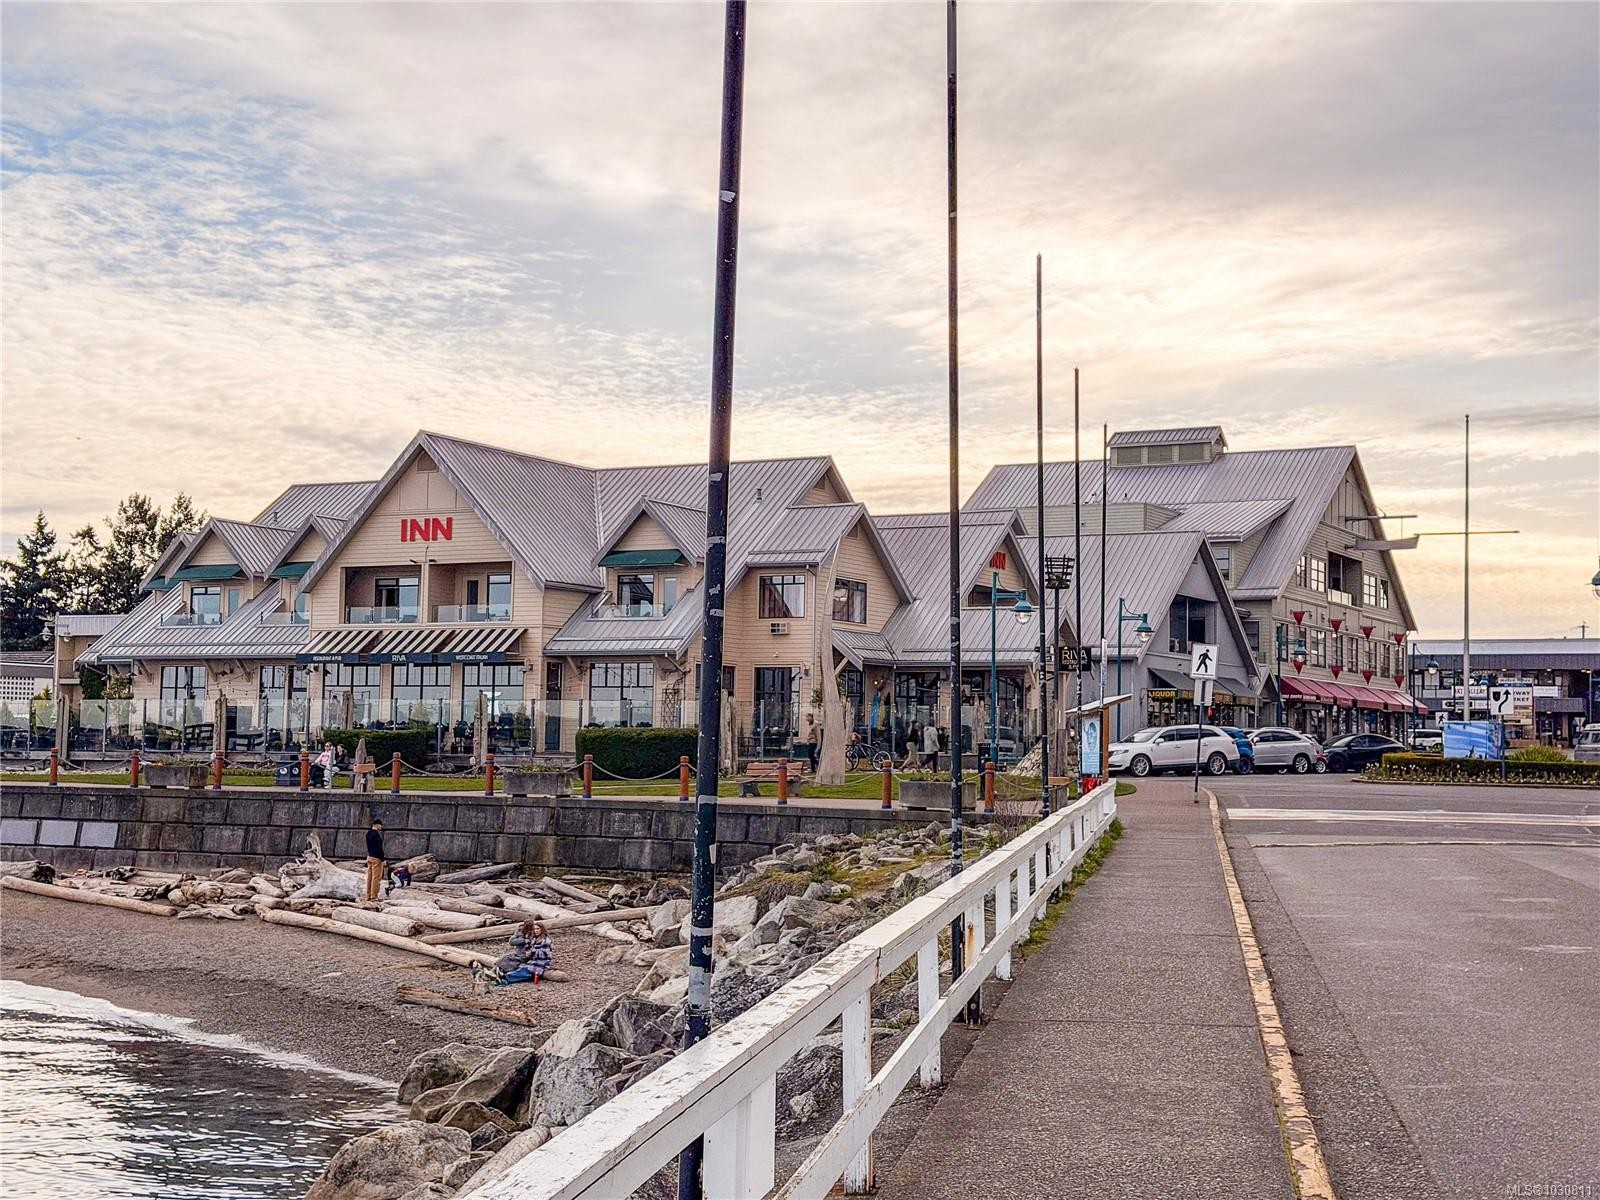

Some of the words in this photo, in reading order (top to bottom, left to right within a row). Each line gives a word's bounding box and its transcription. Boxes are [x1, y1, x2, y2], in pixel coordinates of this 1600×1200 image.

[400, 517, 453, 542] INN
[391, 654, 406, 662] RIVA
[1148, 690, 1176, 698] LIQUOR
